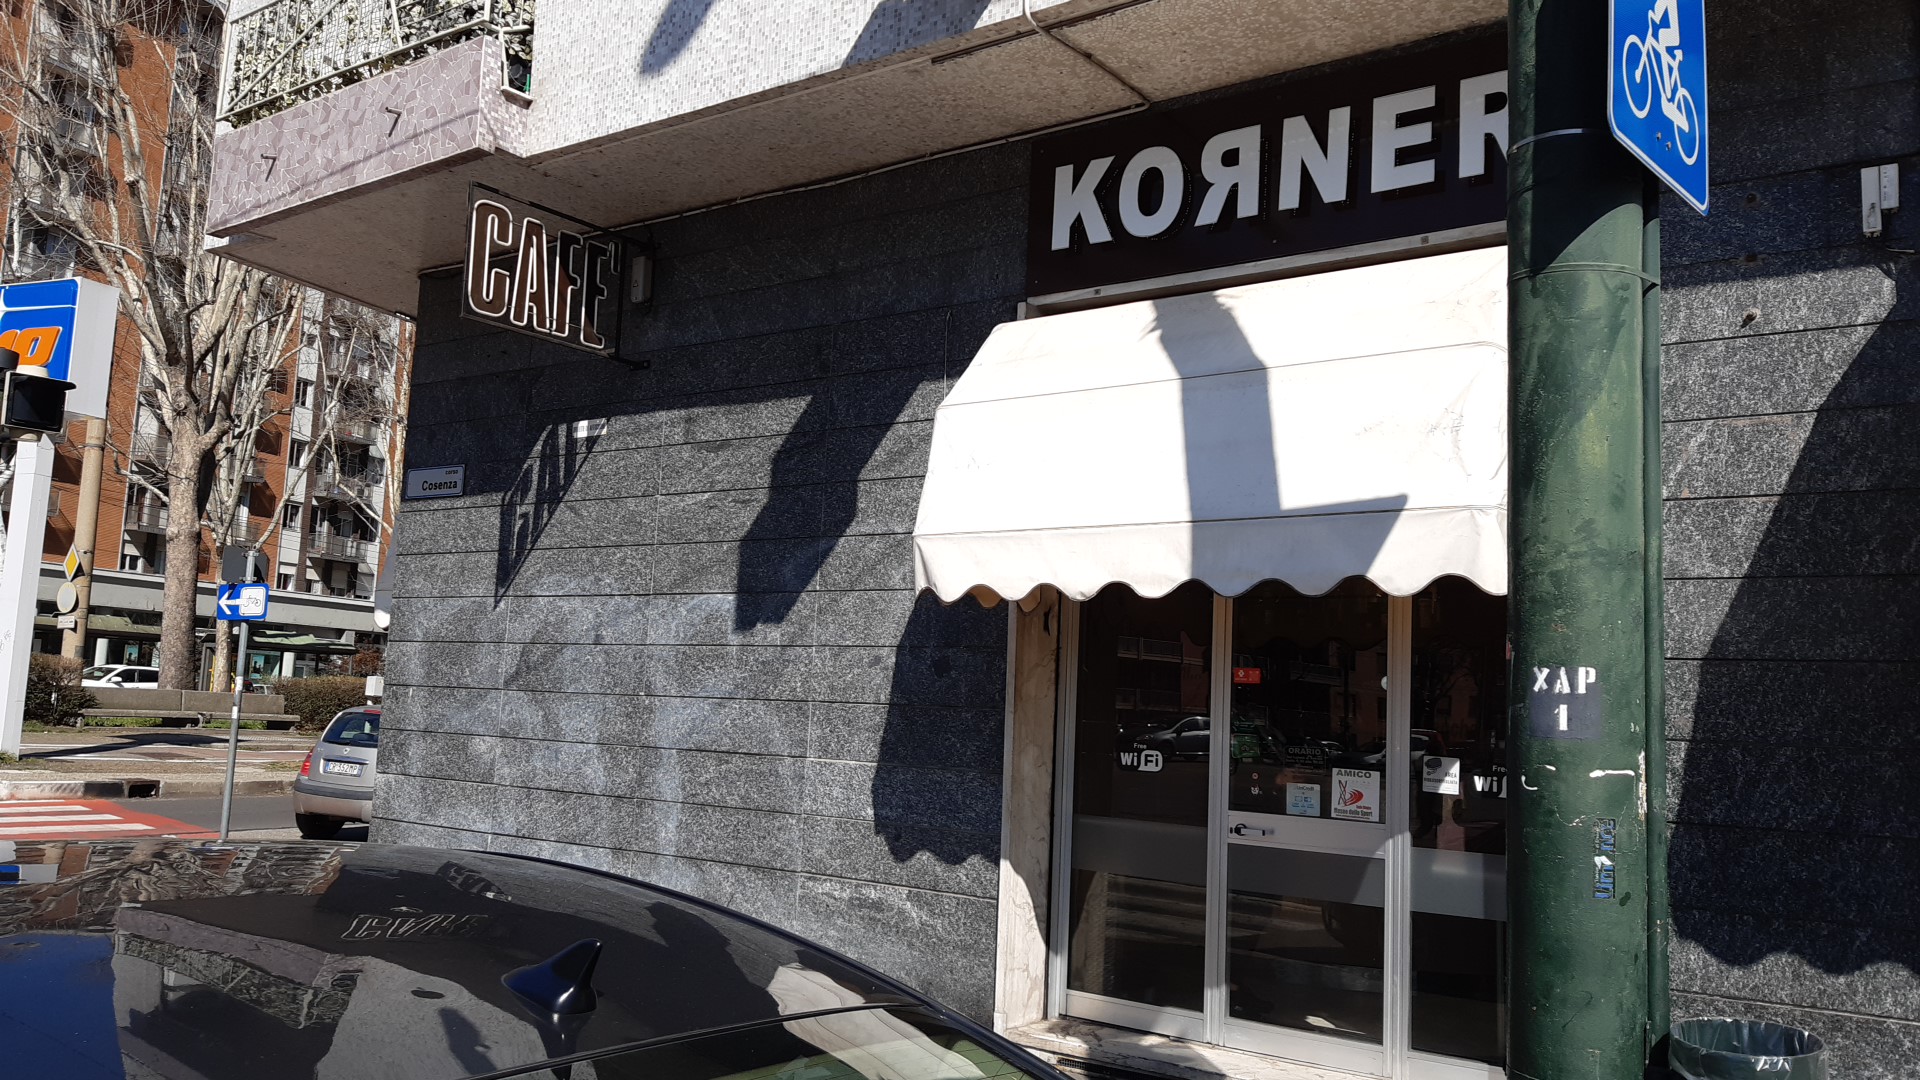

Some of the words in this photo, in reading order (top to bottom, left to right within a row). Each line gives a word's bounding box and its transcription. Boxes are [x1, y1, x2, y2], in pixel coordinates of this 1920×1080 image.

[421, 480, 458, 491] Cosenza
[1533, 666, 1596, 694] XAP
[1554, 704, 1568, 731] 1
[1288, 747, 1321, 756] ORARIO
[1120, 751, 1161, 769] WiFi
[1336, 769, 1372, 778] AMICO
